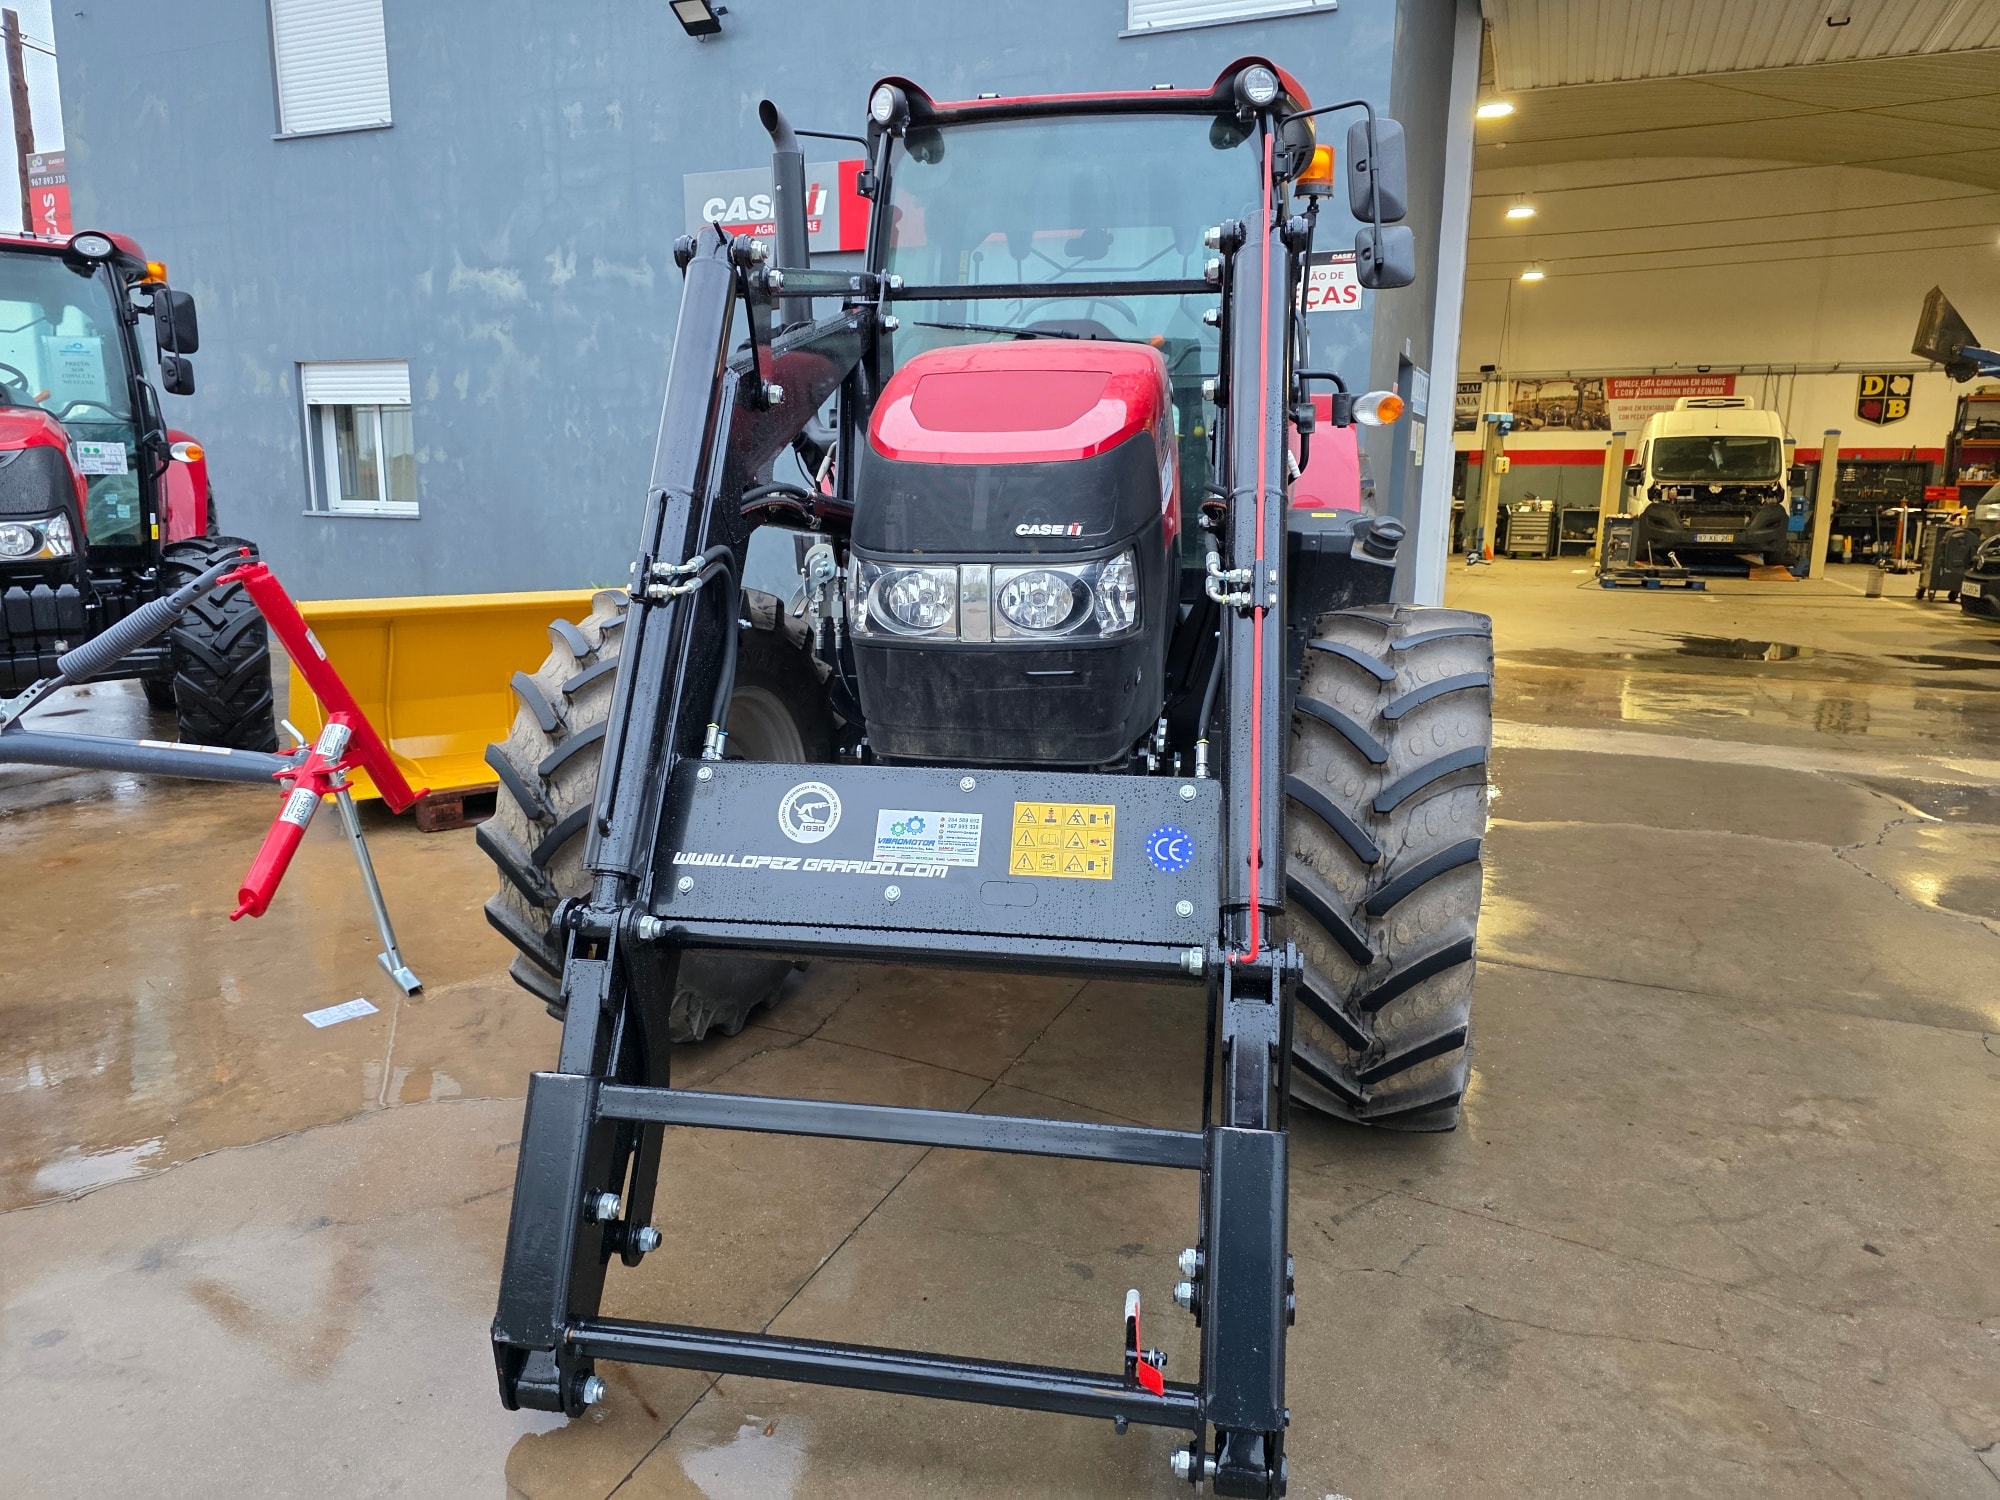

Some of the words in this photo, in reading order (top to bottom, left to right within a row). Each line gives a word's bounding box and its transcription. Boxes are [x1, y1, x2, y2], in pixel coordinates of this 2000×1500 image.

[31, 178, 42, 187] 967
[43, 176, 54, 186] 893
[55, 175, 66, 184] 338
[703, 194, 775, 223] CAS
[1330, 271, 1344, 280] DE
[1306, 285, 1357, 309] ÇAS
[1457, 384, 1481, 393] ICIAL
[1614, 380, 1639, 388] COMECE
[1641, 379, 1655, 388] ESTA
[1656, 378, 1689, 387] CAMPANHA
[1690, 378, 1700, 387] EM
[1701, 377, 1727, 387] GRANDE
[1862, 376, 1884, 395] D
[1614, 389, 1619, 397] E
[1620, 388, 1634, 397] COM
[1640, 387, 1652, 396] SUA
[1653, 386, 1681, 396] MÁQUINA
[1682, 387, 1696, 395] BEM
[1696, 386, 1724, 395] AFINADA
[1456, 397, 1478, 406] AMA
[1886, 399, 1906, 418] B
[1015, 524, 1064, 536] CASE
[878, 837, 936, 847] VIBROMOTOR
[1154, 837, 1184, 862] CE
[673, 852, 802, 871] WWW.LOPEZ
[802, 858, 948, 878] GARRIDO.COM
